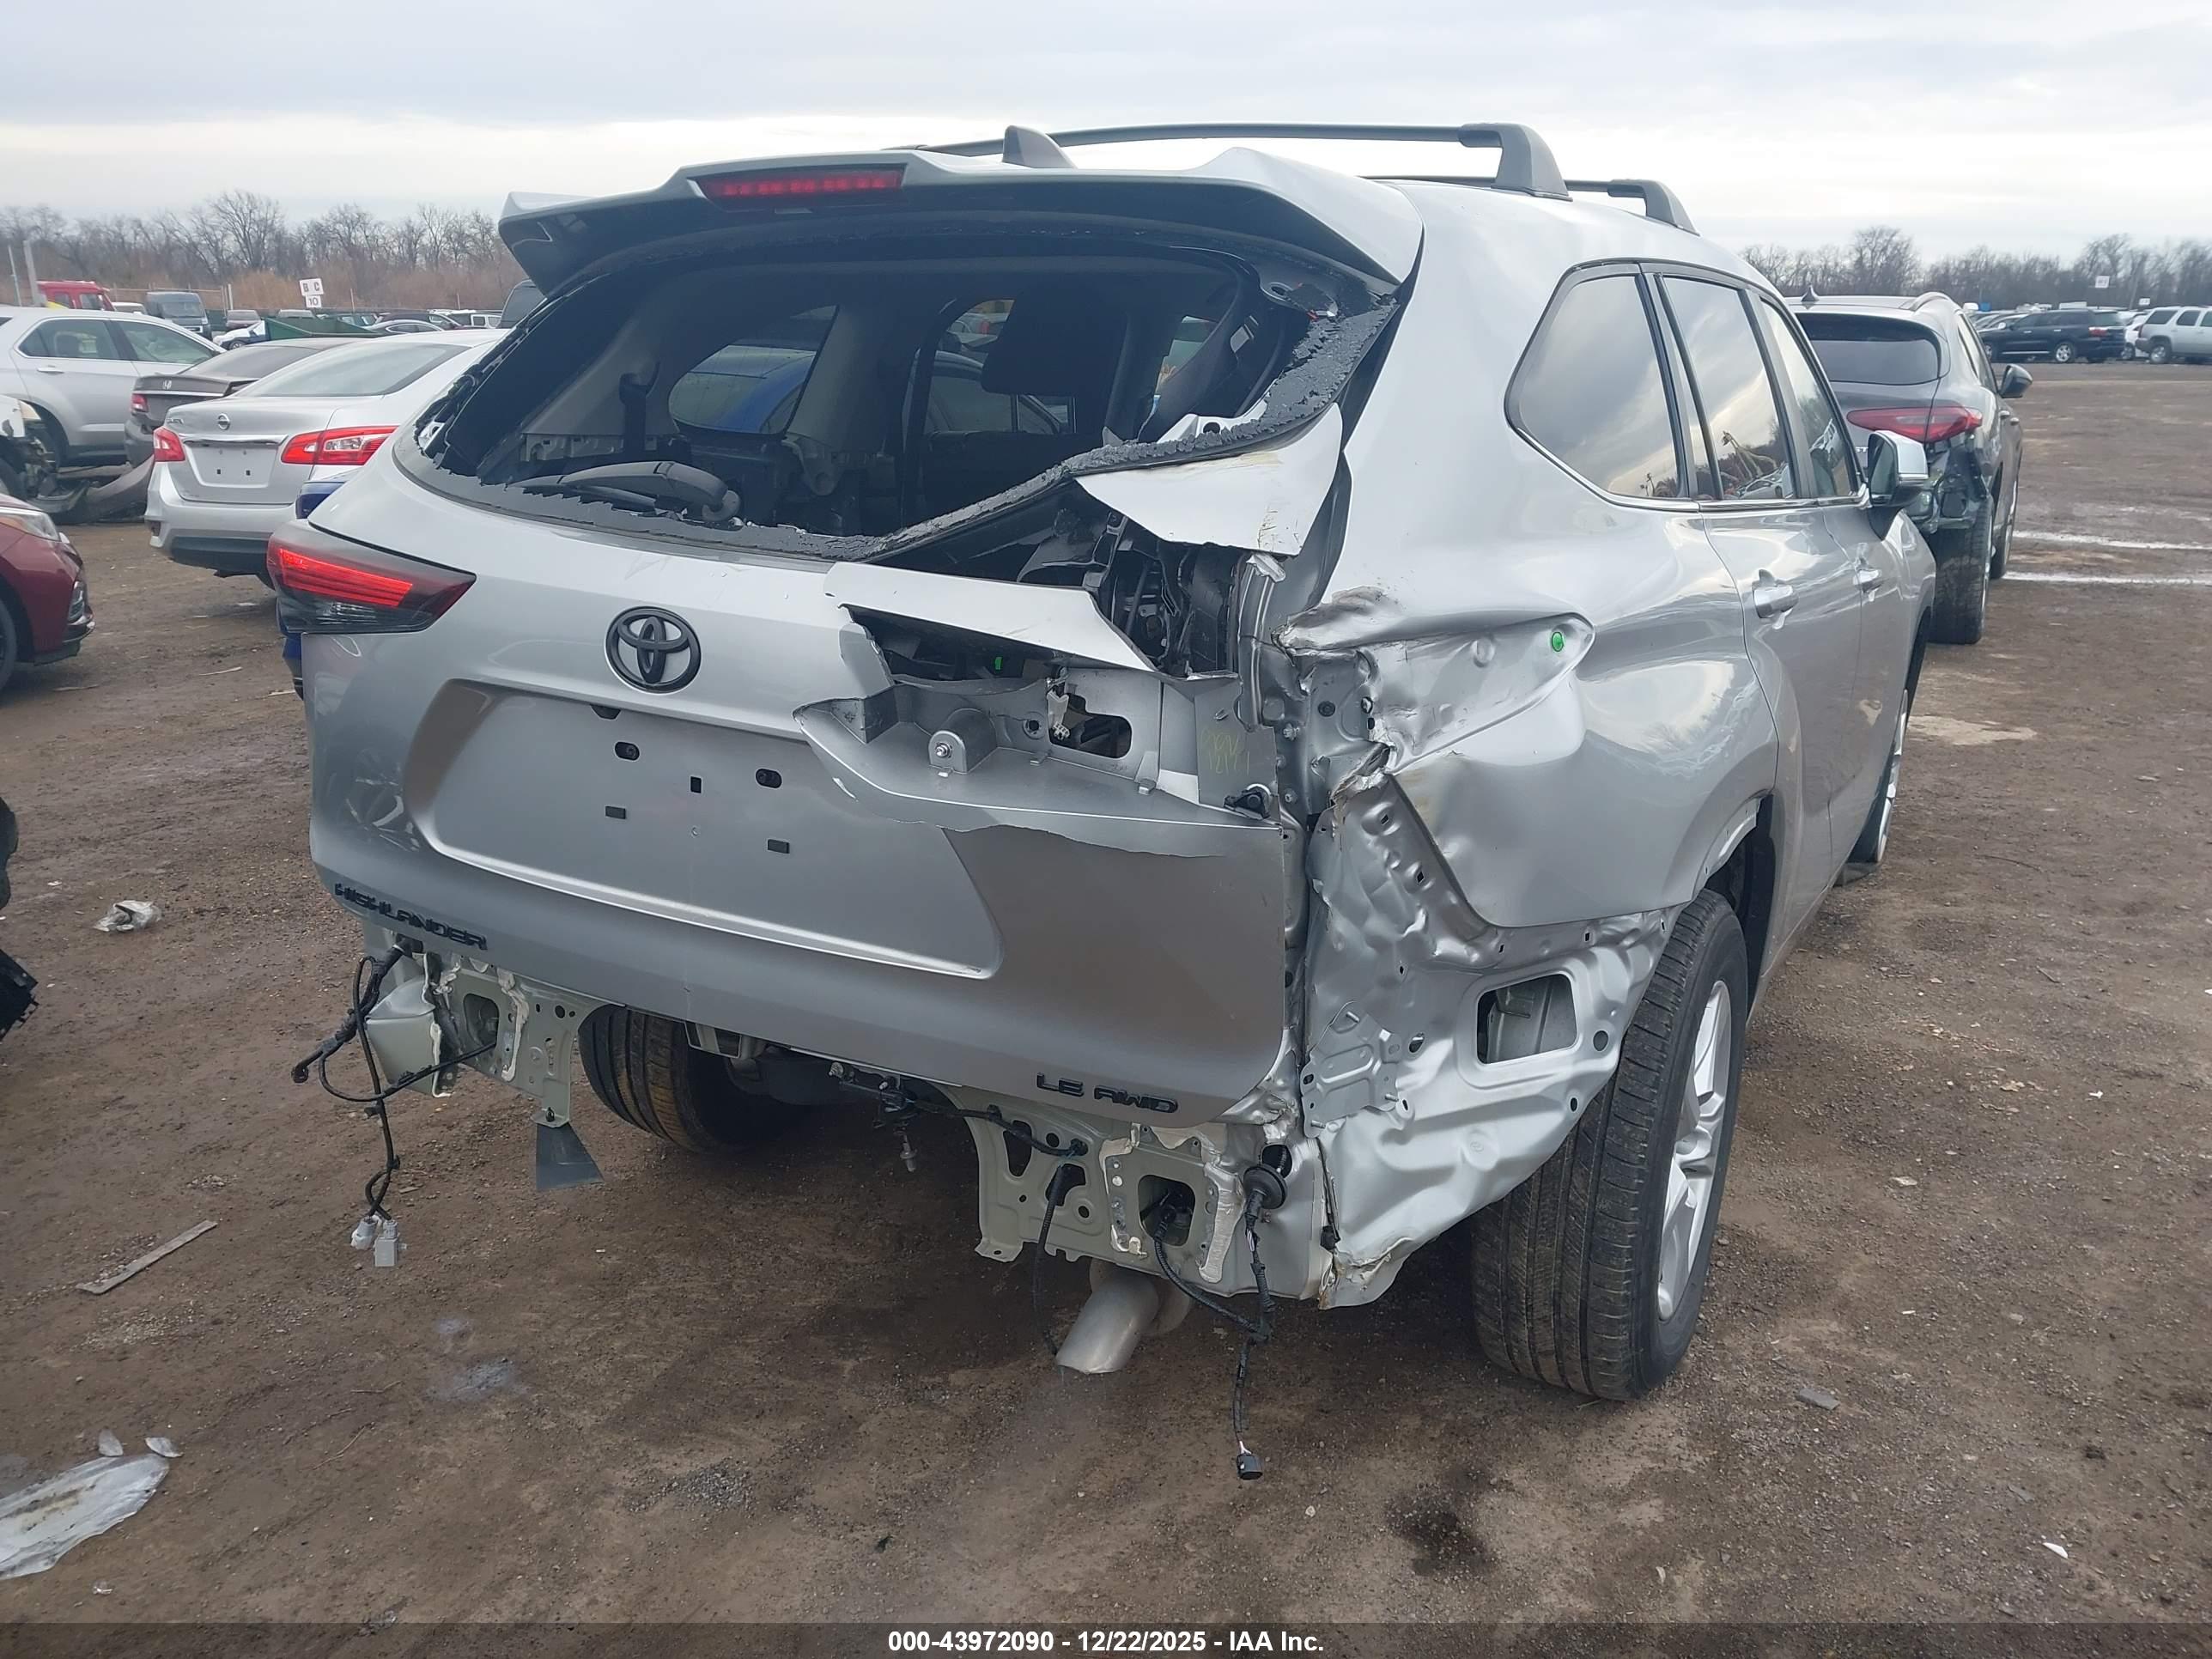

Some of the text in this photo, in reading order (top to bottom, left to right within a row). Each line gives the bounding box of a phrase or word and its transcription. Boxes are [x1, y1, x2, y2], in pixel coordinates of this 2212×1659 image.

[307, 296, 319, 307] 10
[334, 883, 489, 951] HIGHLANDER
[1036, 1072, 1179, 1114] LE AWD
